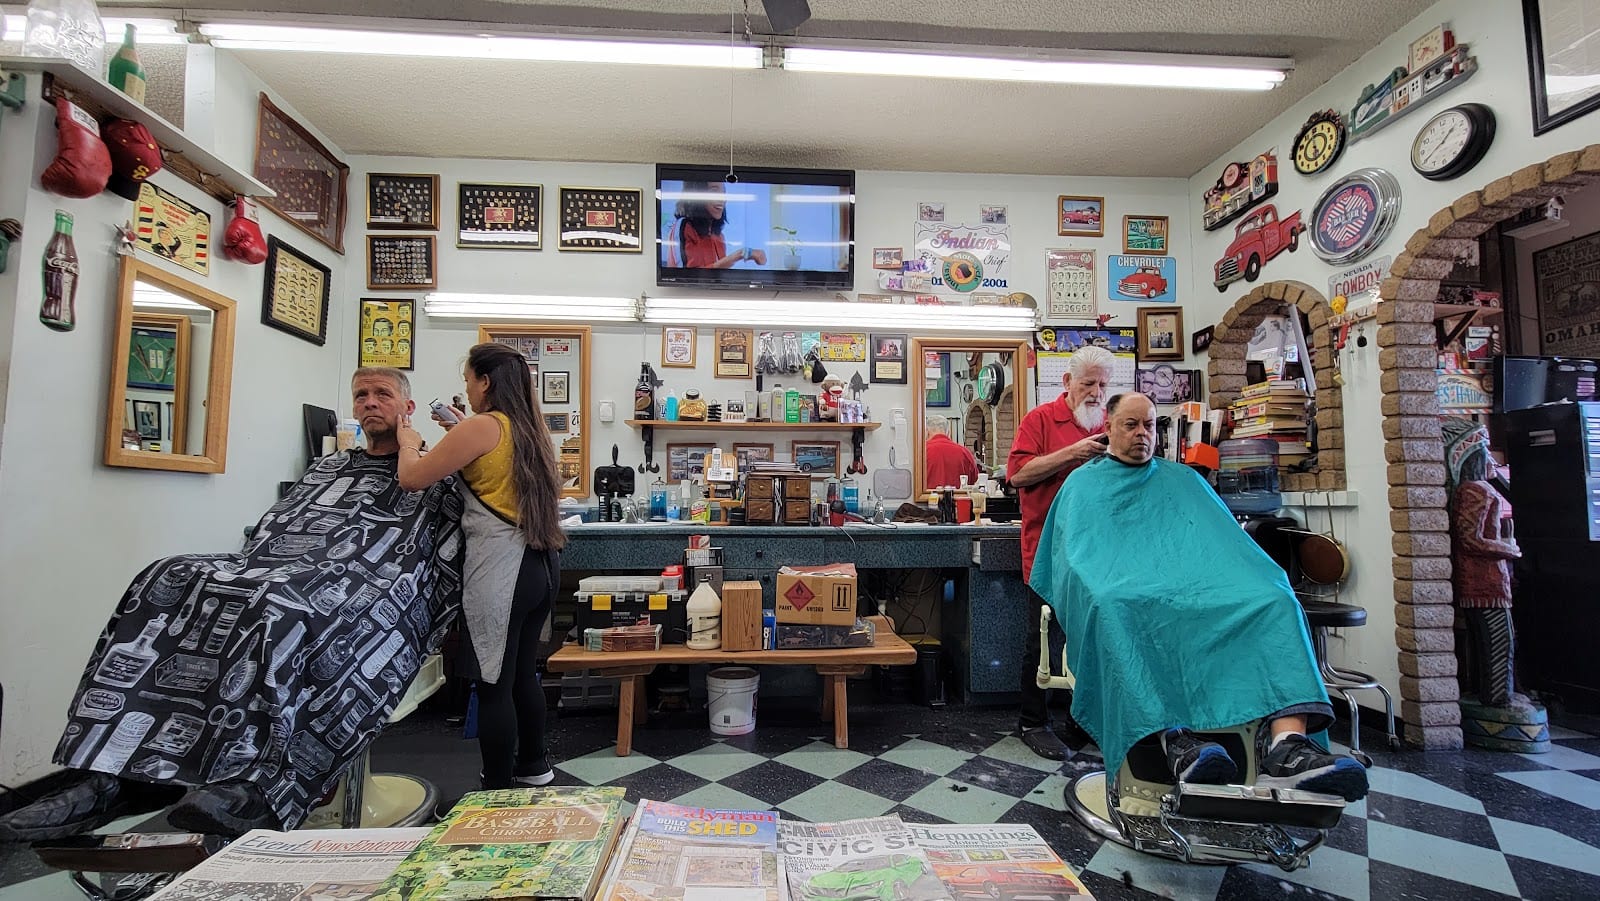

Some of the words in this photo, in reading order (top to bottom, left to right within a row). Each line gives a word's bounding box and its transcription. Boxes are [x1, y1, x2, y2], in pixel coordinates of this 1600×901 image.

[930, 229, 1000, 250] Indian
[1118, 256, 1167, 268] CHEVROLET
[1343, 263, 1373, 278] NEVADA
[982, 278, 1008, 288] 2001
[1336, 267, 1382, 297] COWBOY
[1120, 329, 1134, 337] 2023
[492, 810, 522, 818] 20TH
[463, 816, 592, 830] BASEBALL
[657, 818, 687, 828] BUILD
[663, 824, 686, 833] THIS
[687, 822, 758, 836] SHED
[479, 828, 564, 836] CHRONICLE
[778, 823, 820, 838] CAR
[911, 828, 1038, 842] Hemmings
[782, 840, 874, 857] CIVIC
